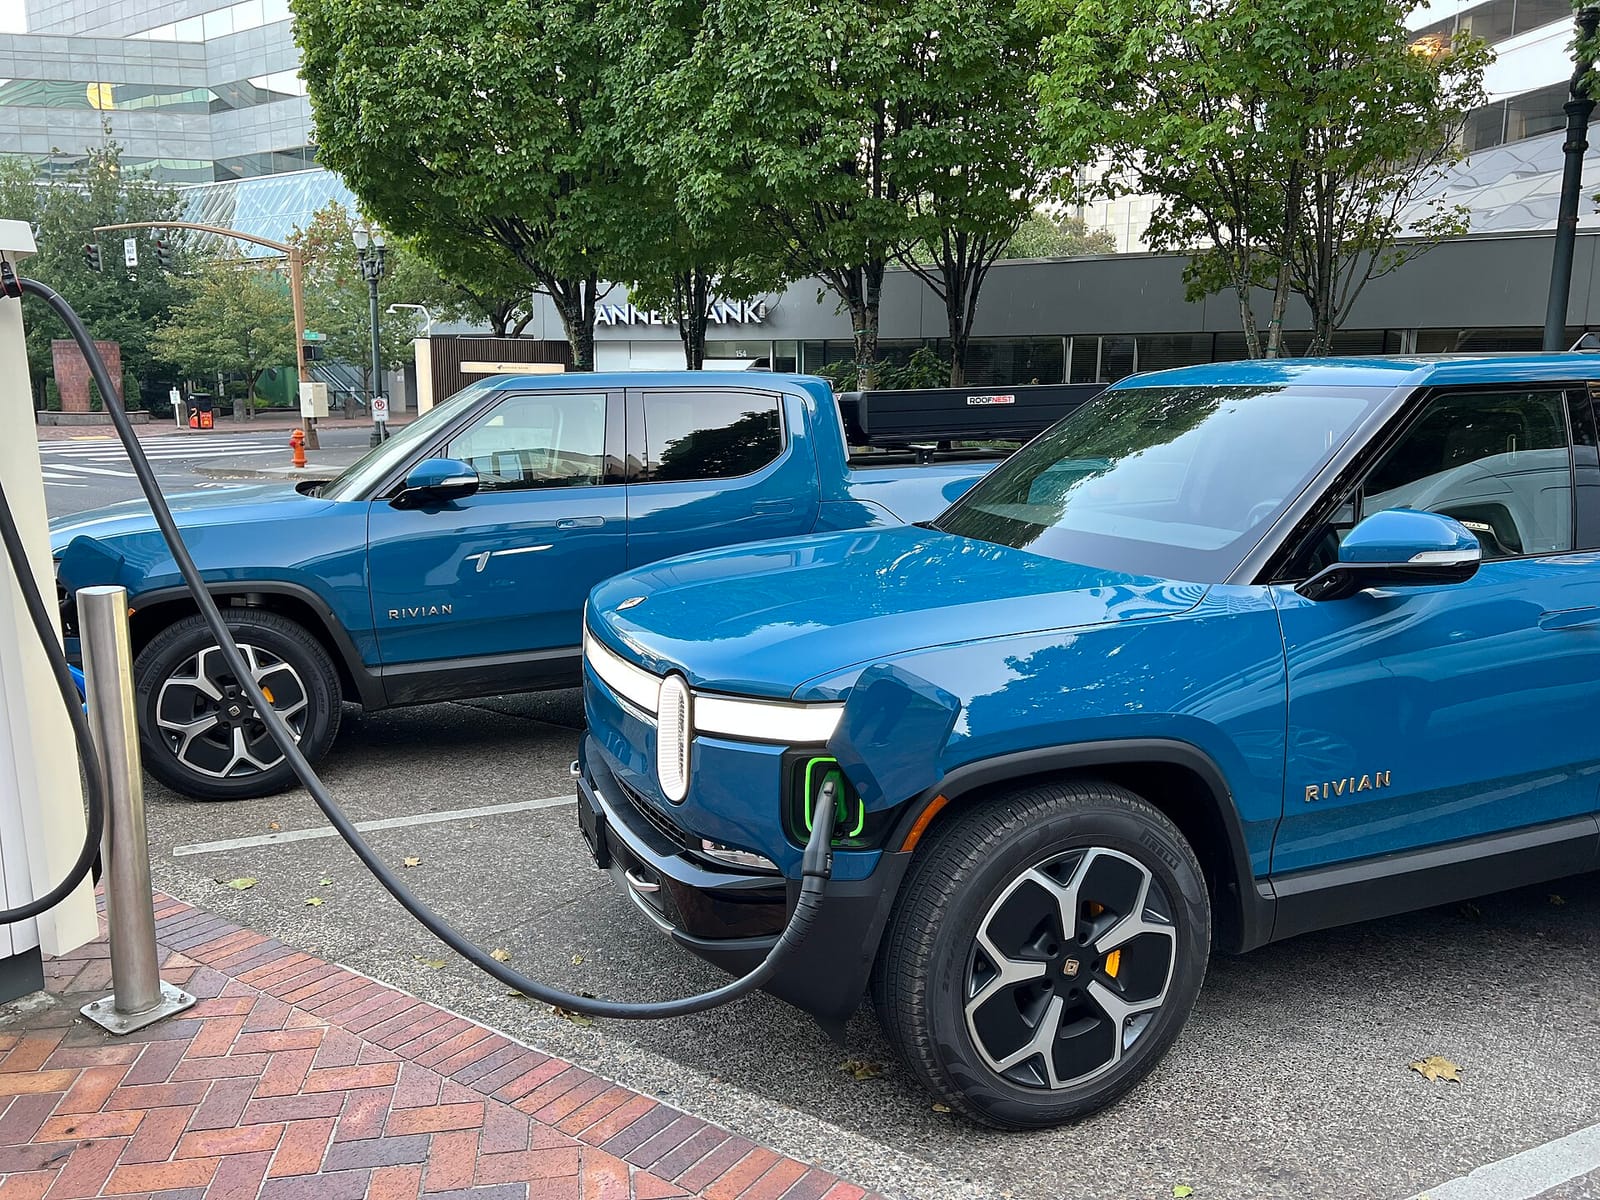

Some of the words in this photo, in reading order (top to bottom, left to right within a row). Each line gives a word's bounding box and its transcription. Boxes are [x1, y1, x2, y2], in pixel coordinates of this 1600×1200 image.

[702, 300, 762, 324] ANK
[969, 396, 1013, 404] ROOFNEST
[388, 604, 453, 619] RIVIAN
[1304, 770, 1392, 802] RIVIAN
